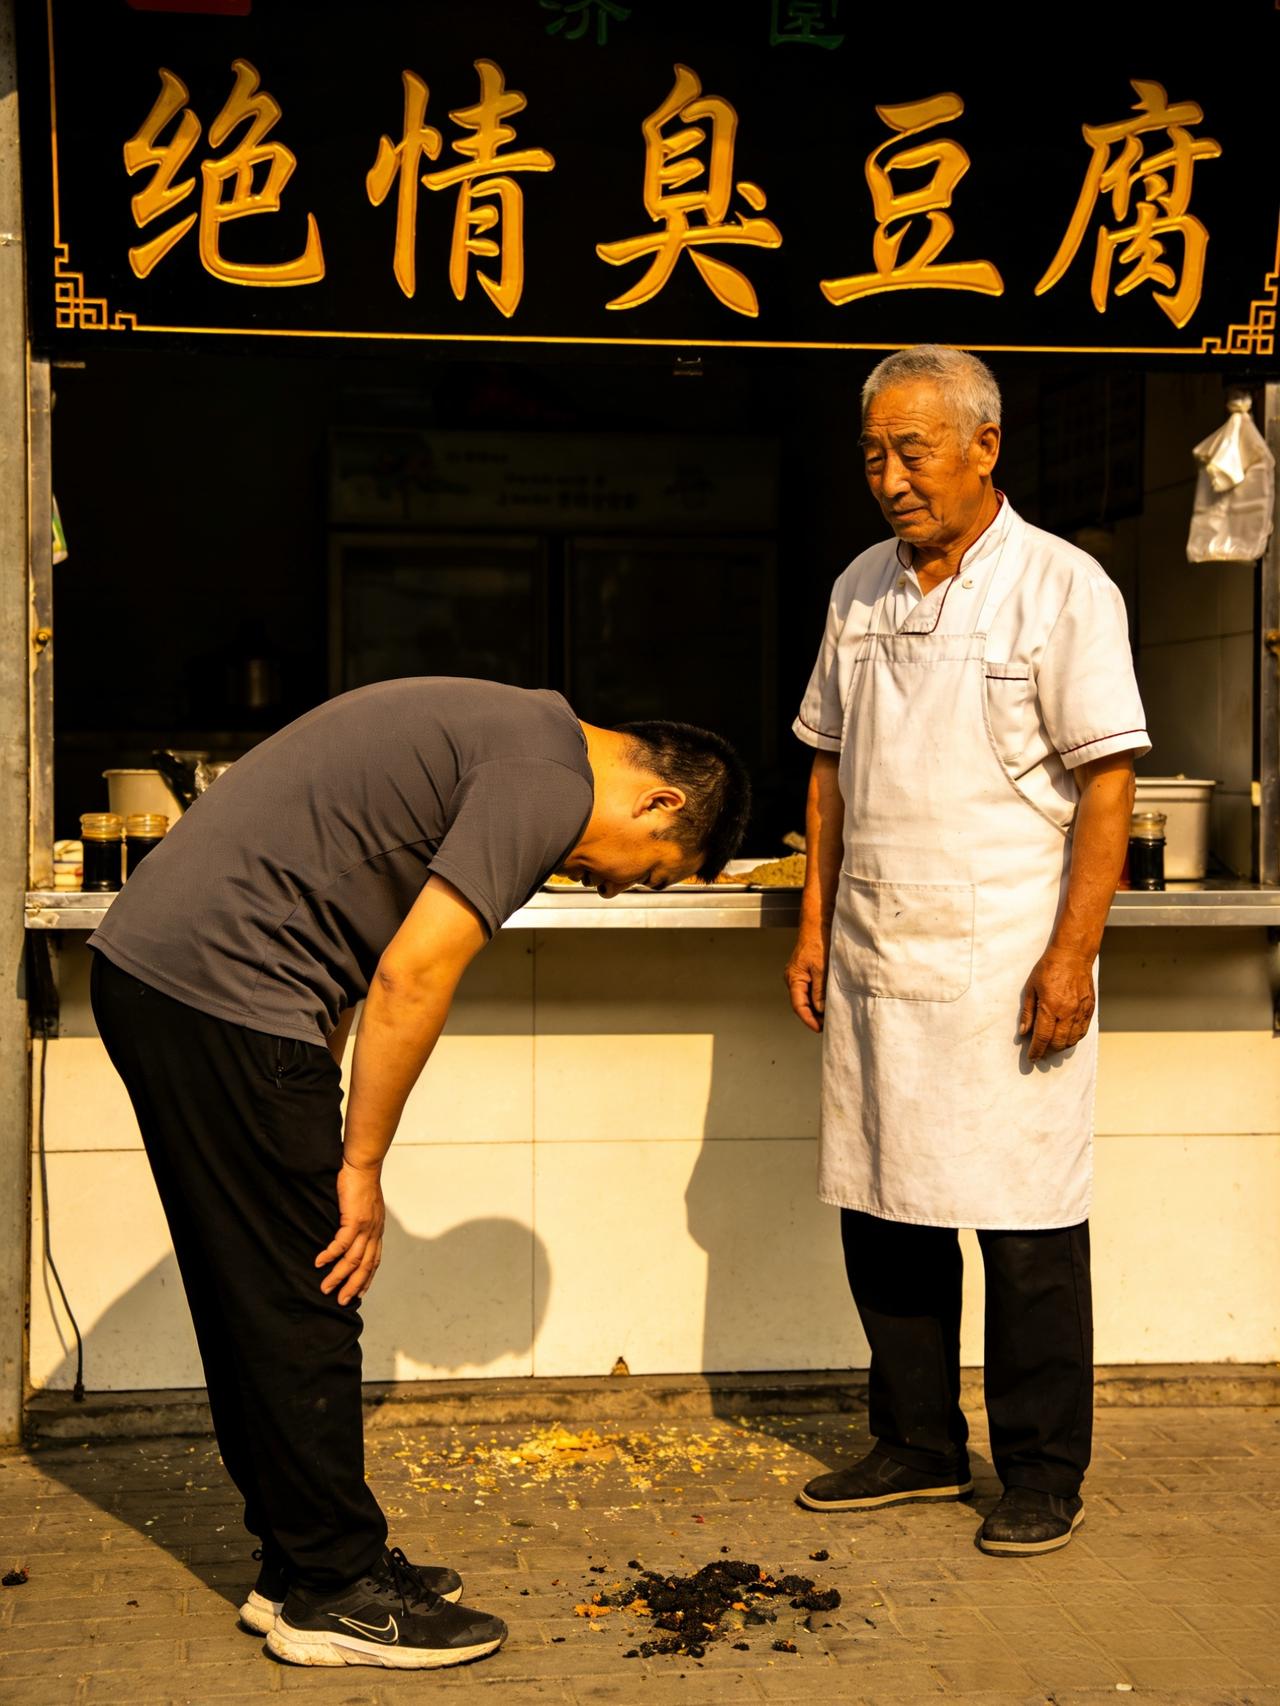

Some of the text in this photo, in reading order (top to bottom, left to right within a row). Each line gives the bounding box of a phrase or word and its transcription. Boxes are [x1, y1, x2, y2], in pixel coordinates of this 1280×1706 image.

[123, 60, 1222, 329] 绝情臭豆腐
